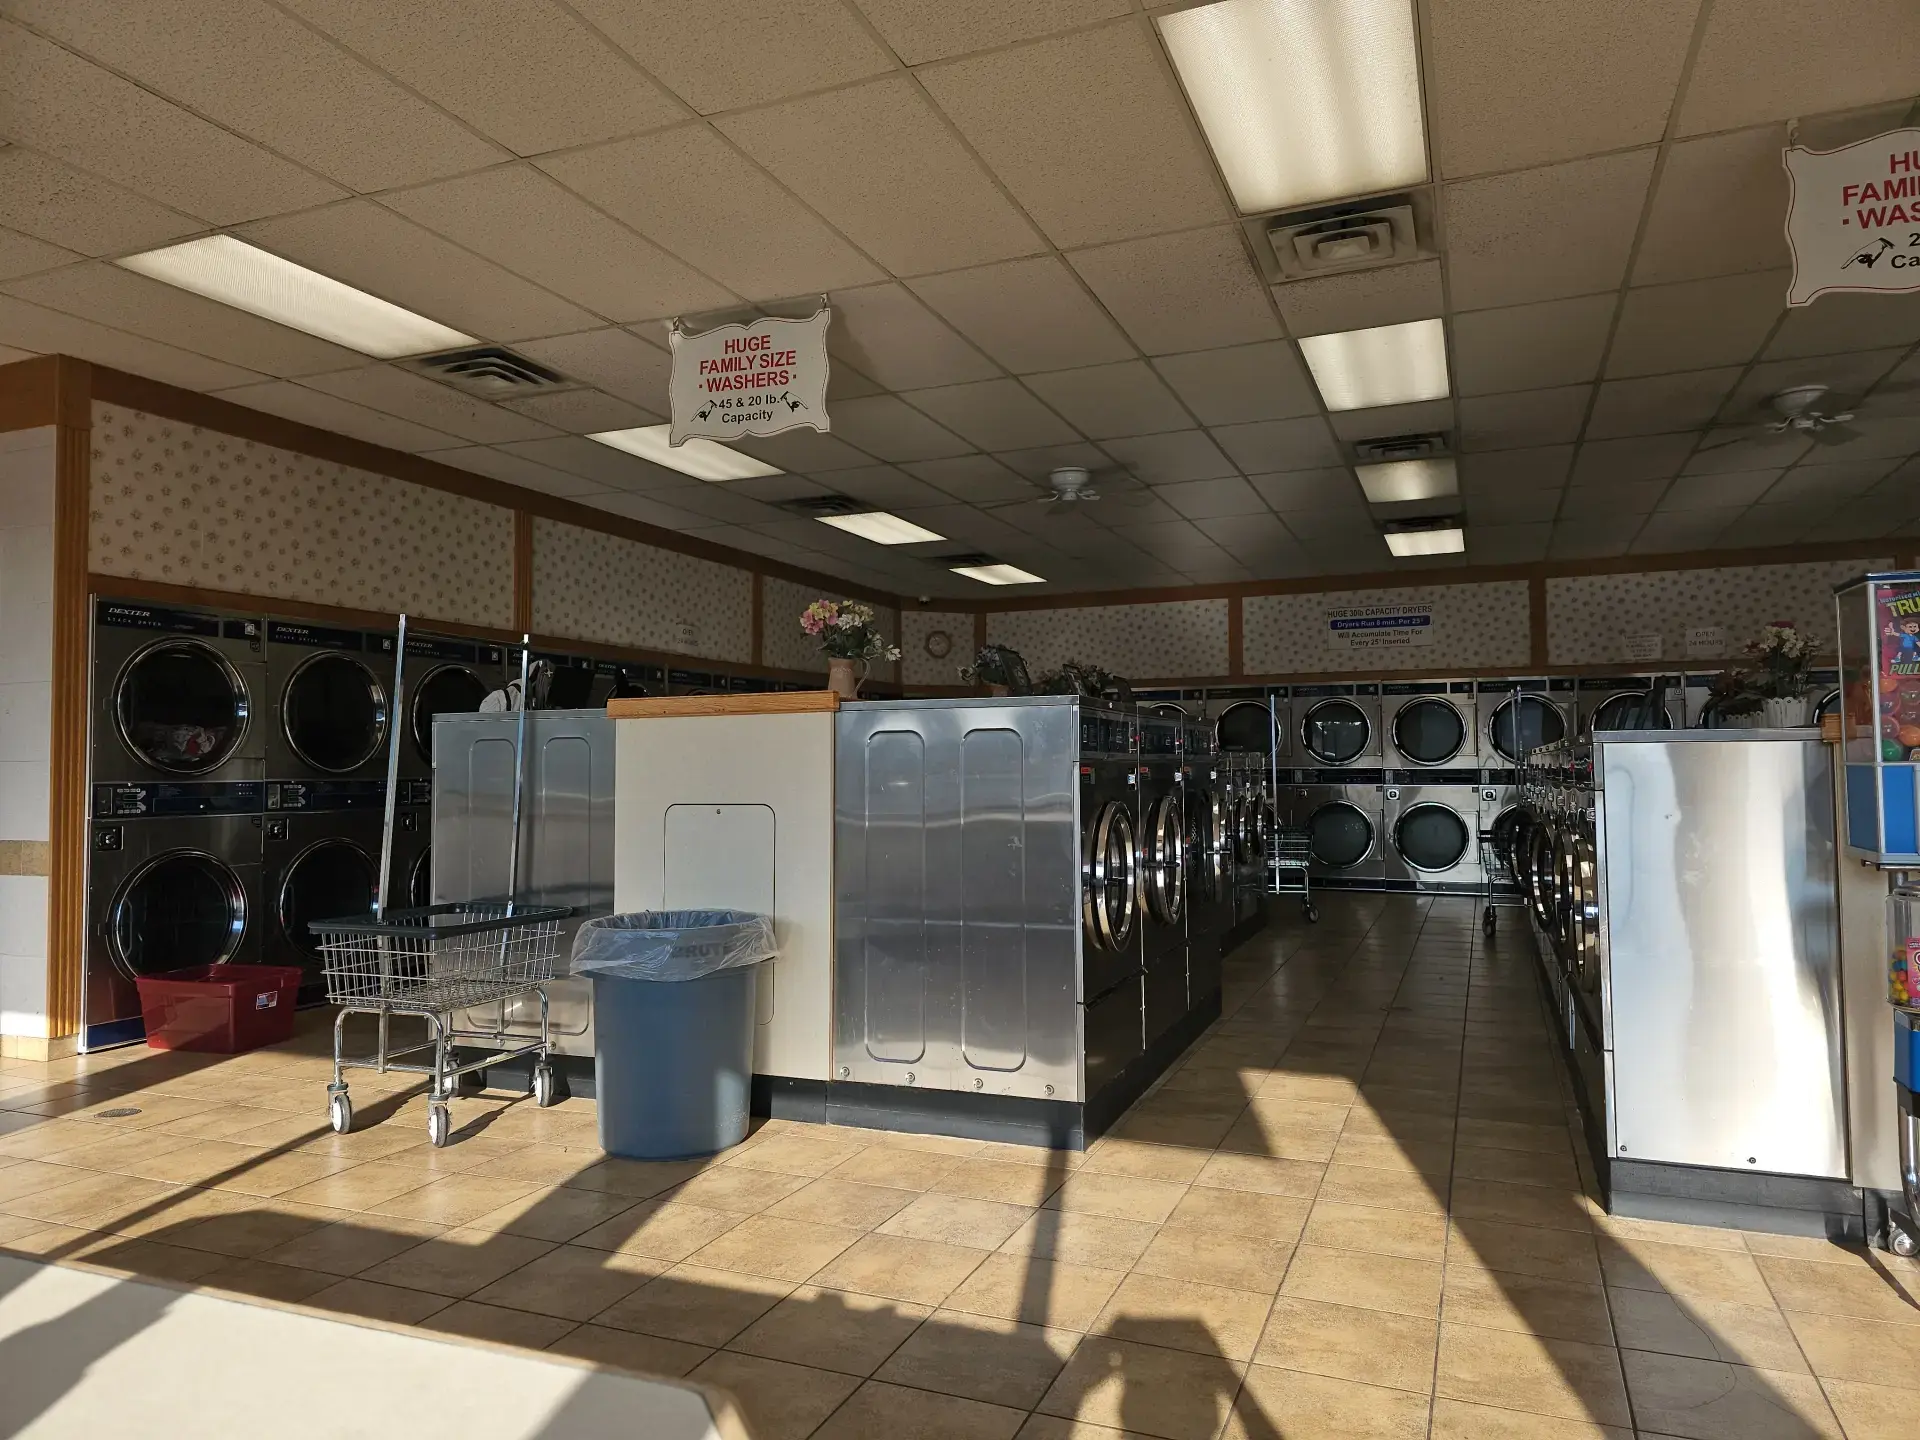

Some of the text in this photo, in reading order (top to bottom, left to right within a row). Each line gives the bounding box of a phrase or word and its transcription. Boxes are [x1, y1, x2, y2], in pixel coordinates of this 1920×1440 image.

[1842, 175, 1920, 206] FAMI
[724, 335, 771, 354] HUGE
[700, 350, 797, 375] FAMILY SIZE
[706, 370, 789, 393] WASHERS
[718, 398, 733, 409] 45
[736, 397, 745, 408] &
[748, 395, 762, 406] 20
[722, 409, 774, 425] Capacity
[107, 606, 151, 617] DEXTER
[1328, 609, 1348, 618] HUGE
[1365, 606, 1401, 616] CAPACITY
[1402, 604, 1433, 615] DRYERS
[1361, 619, 1375, 627] Run
[1398, 617, 1411, 625] Per
[276, 626, 309, 635] DEXTER
[1351, 629, 1391, 638] Accumulate
[1410, 627, 1424, 635] For
[1350, 639, 1370, 647] Every
[1382, 636, 1410, 645] Inserted
